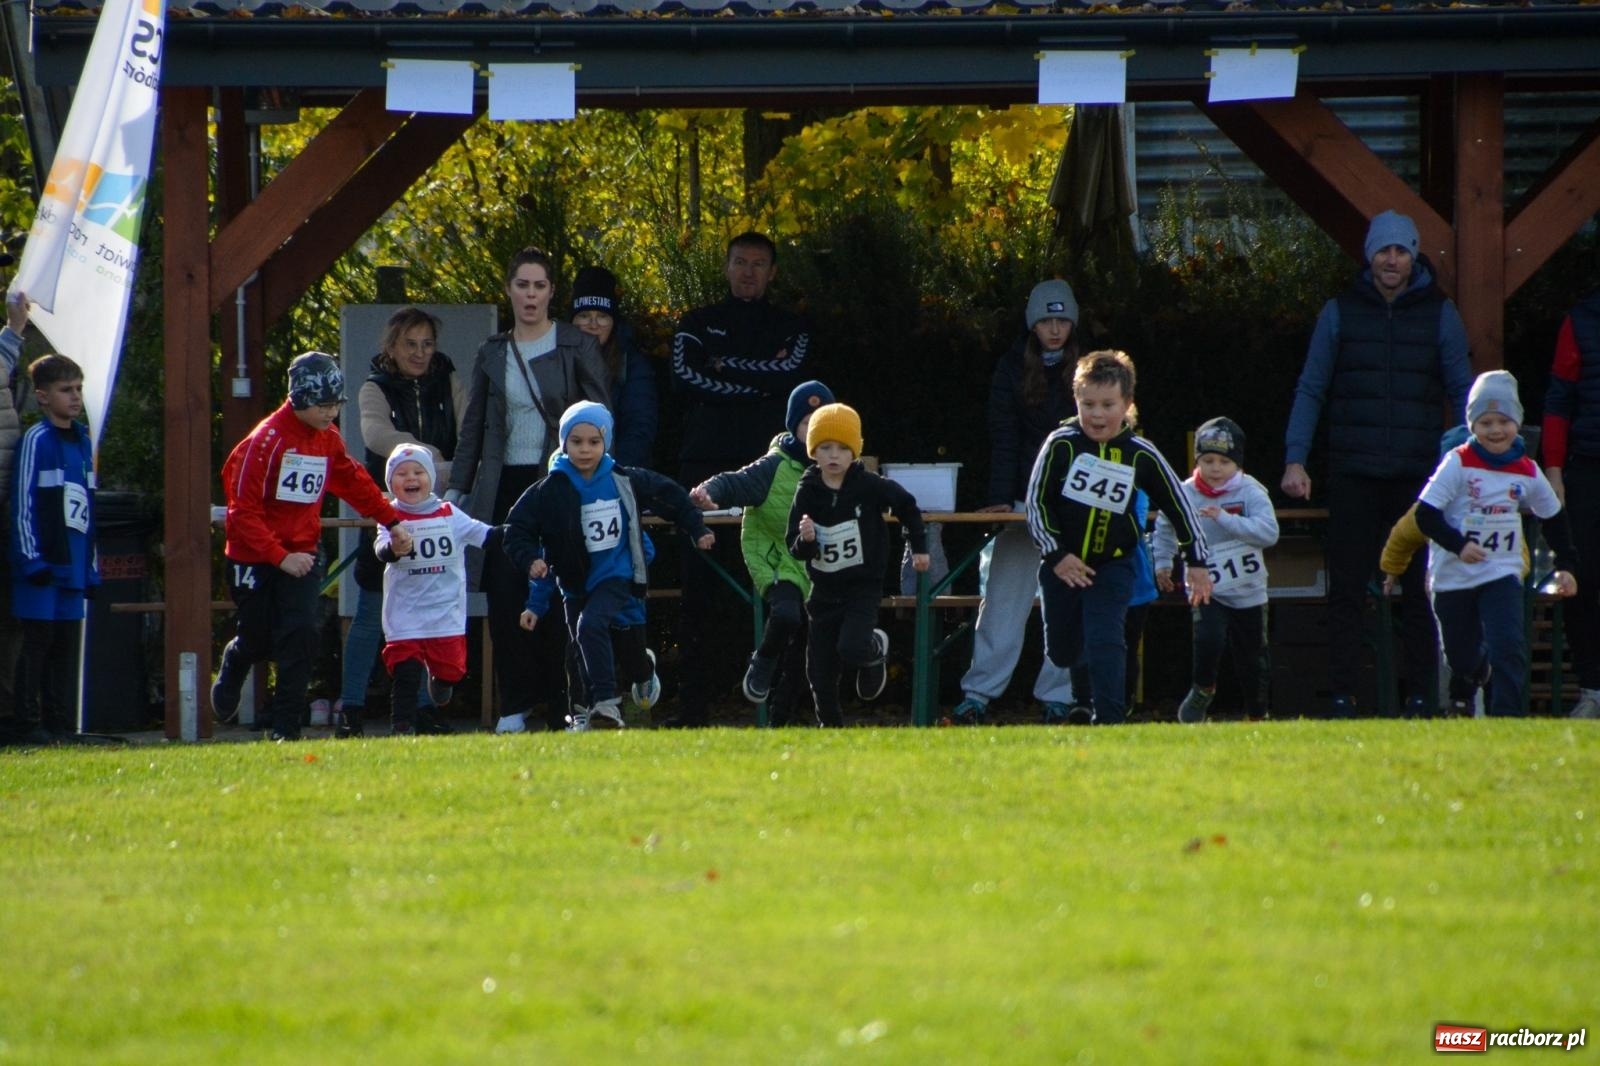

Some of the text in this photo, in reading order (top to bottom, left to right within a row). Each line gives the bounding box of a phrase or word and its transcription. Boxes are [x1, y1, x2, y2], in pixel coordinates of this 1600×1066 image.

[573, 296, 611, 309] ALPINESTARS
[282, 471, 323, 494] 469
[1070, 469, 1128, 503] 545
[69, 498, 88, 524] 74
[583, 517, 619, 542] 34
[1466, 530, 1515, 551] 541
[233, 564, 256, 589] 14
[1207, 553, 1260, 584] 515
